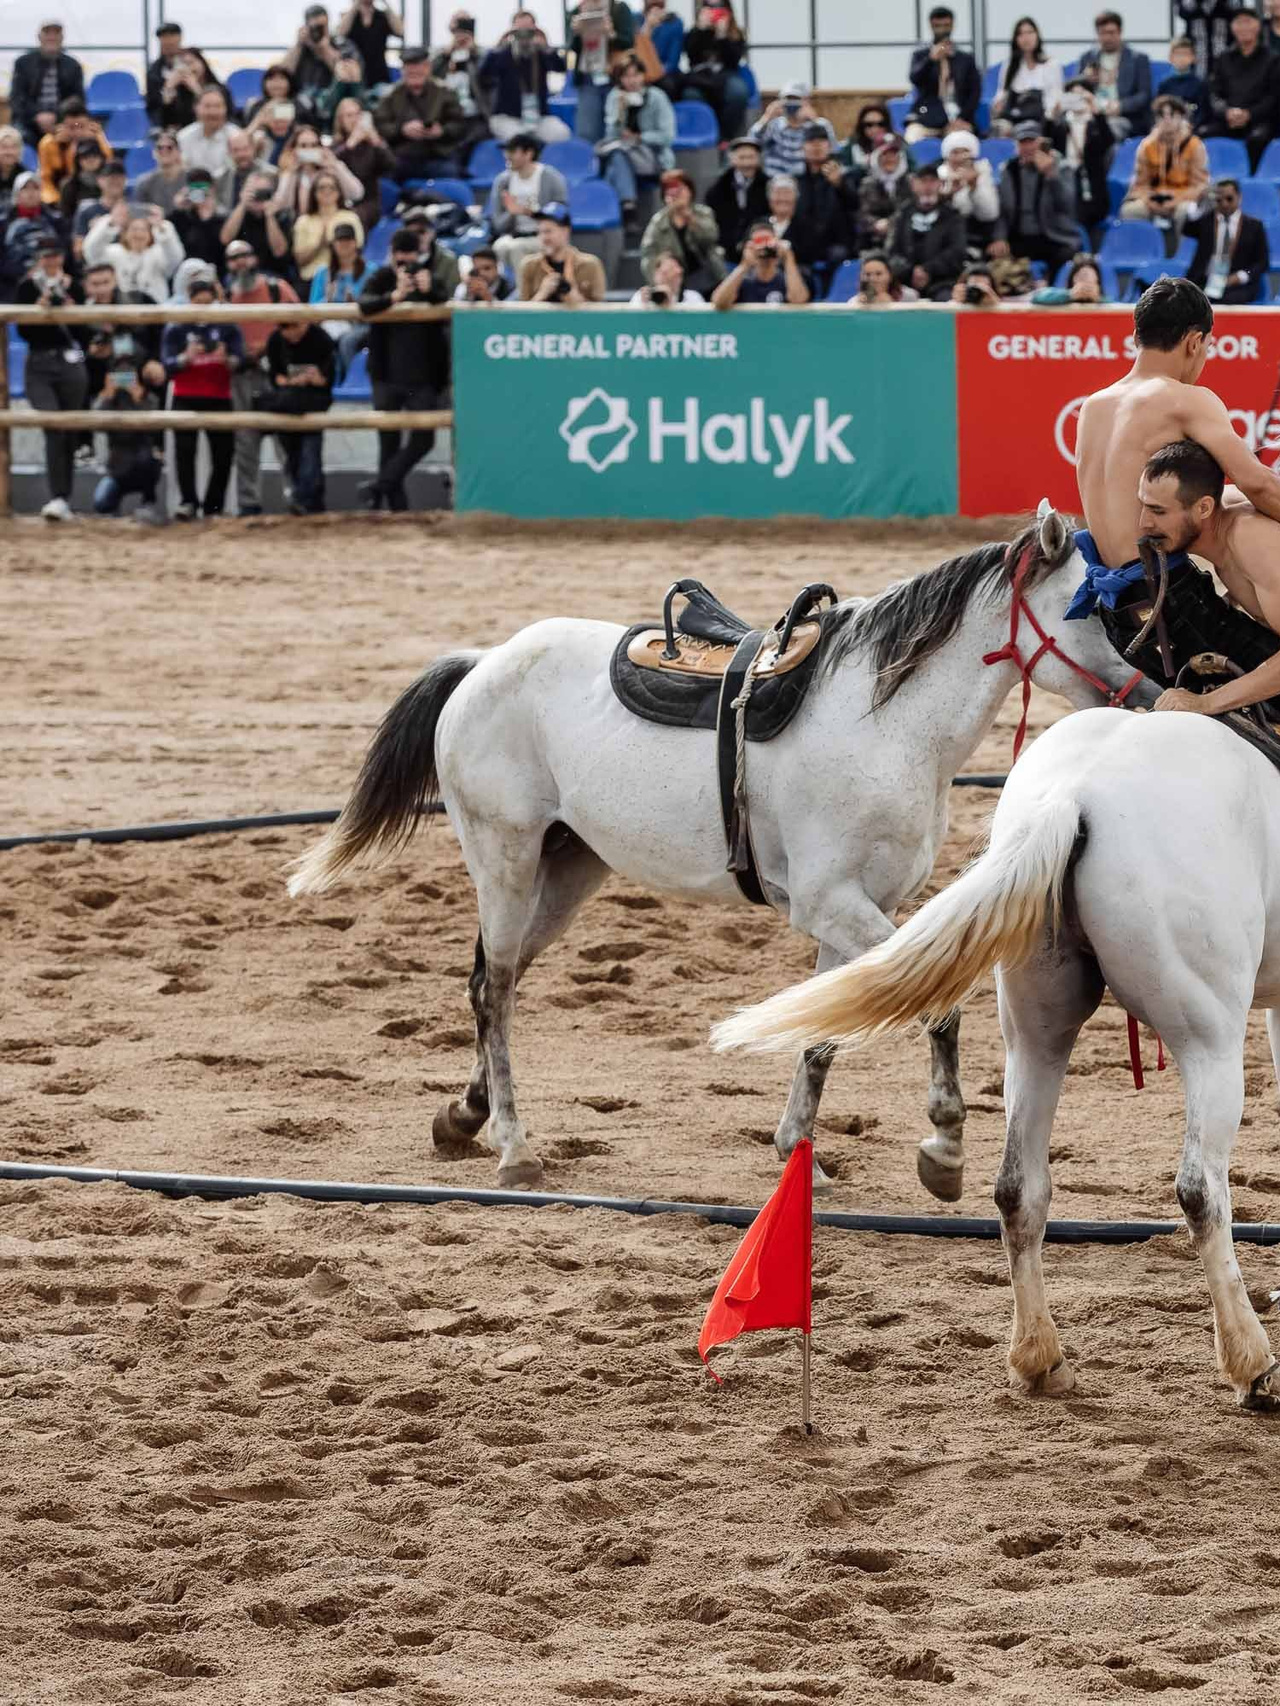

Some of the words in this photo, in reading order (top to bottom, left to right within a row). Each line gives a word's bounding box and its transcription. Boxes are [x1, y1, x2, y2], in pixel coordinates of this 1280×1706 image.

[484, 334, 610, 359] GENERAL
[616, 334, 738, 358] PARTNER
[987, 334, 1119, 360] GENERAL
[648, 397, 855, 478] Halyk
